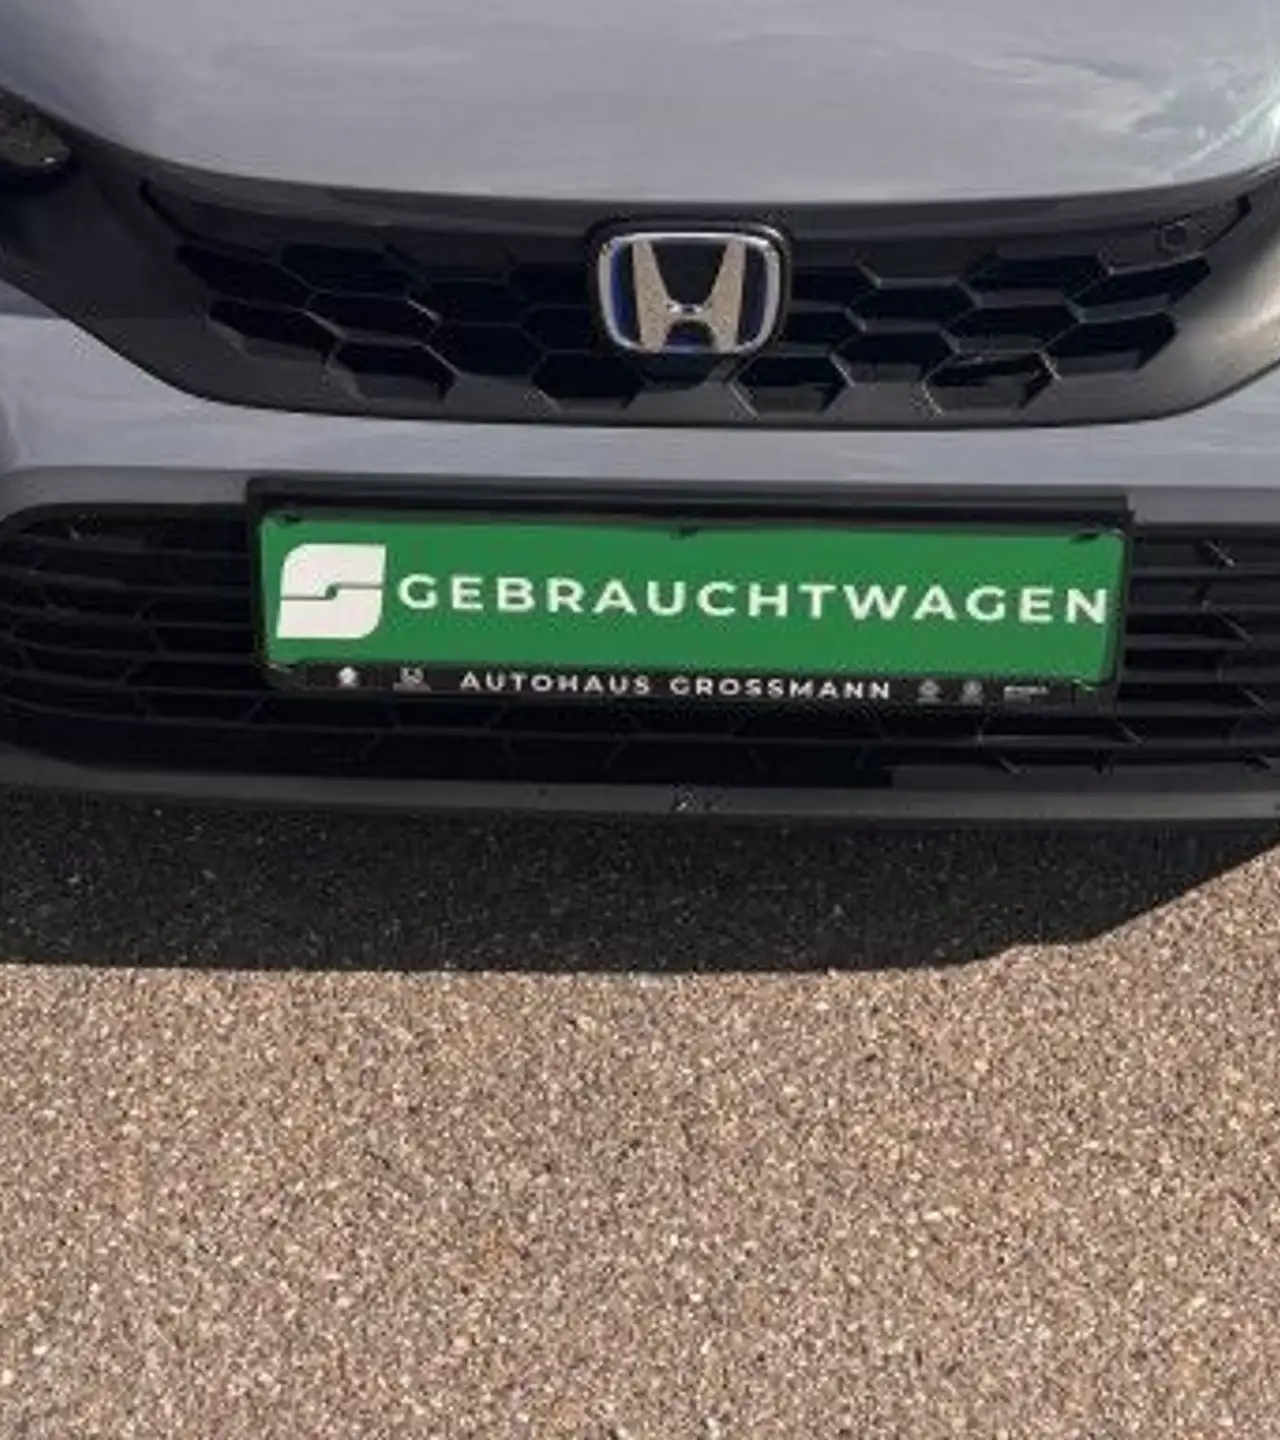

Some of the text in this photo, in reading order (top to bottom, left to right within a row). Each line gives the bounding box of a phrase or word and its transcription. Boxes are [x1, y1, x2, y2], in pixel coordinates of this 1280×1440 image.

[396, 572, 1108, 625] GEBRAUCHTWAGEN
[460, 671, 891, 700] AUTOHAUS GROSSMANN
